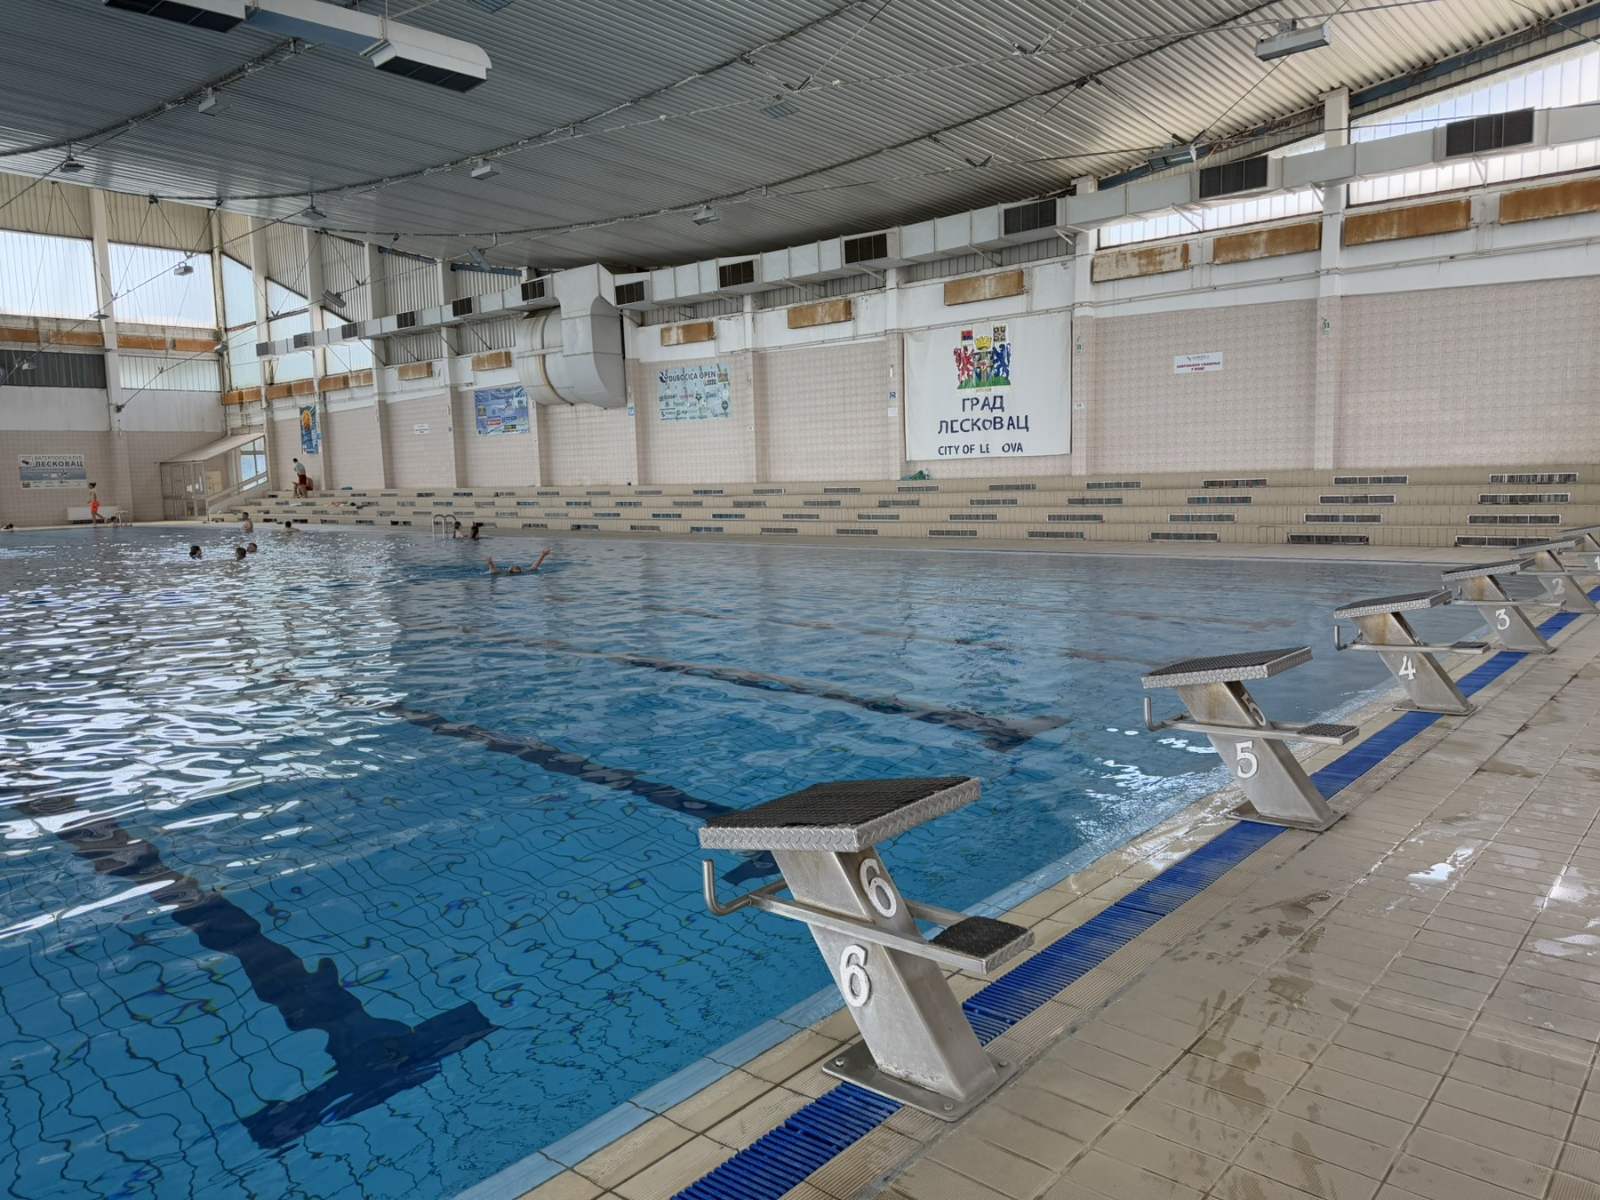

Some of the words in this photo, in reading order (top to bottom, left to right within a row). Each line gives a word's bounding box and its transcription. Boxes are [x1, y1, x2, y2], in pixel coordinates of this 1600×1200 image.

[699, 370, 717, 379] OPEN
[962, 395, 1005, 412] ГРАД
[938, 415, 1029, 434] ЛЕСКОВАЦ
[937, 445, 960, 456] CITY
[962, 444, 976, 454] OF
[1552, 578, 1565, 596] 2
[1495, 608, 1510, 630] 3
[1399, 656, 1416, 680] 4
[1240, 693, 1266, 727] 5
[1235, 741, 1258, 778] 5
[860, 858, 897, 918] 6
[840, 944, 872, 1008] 6
